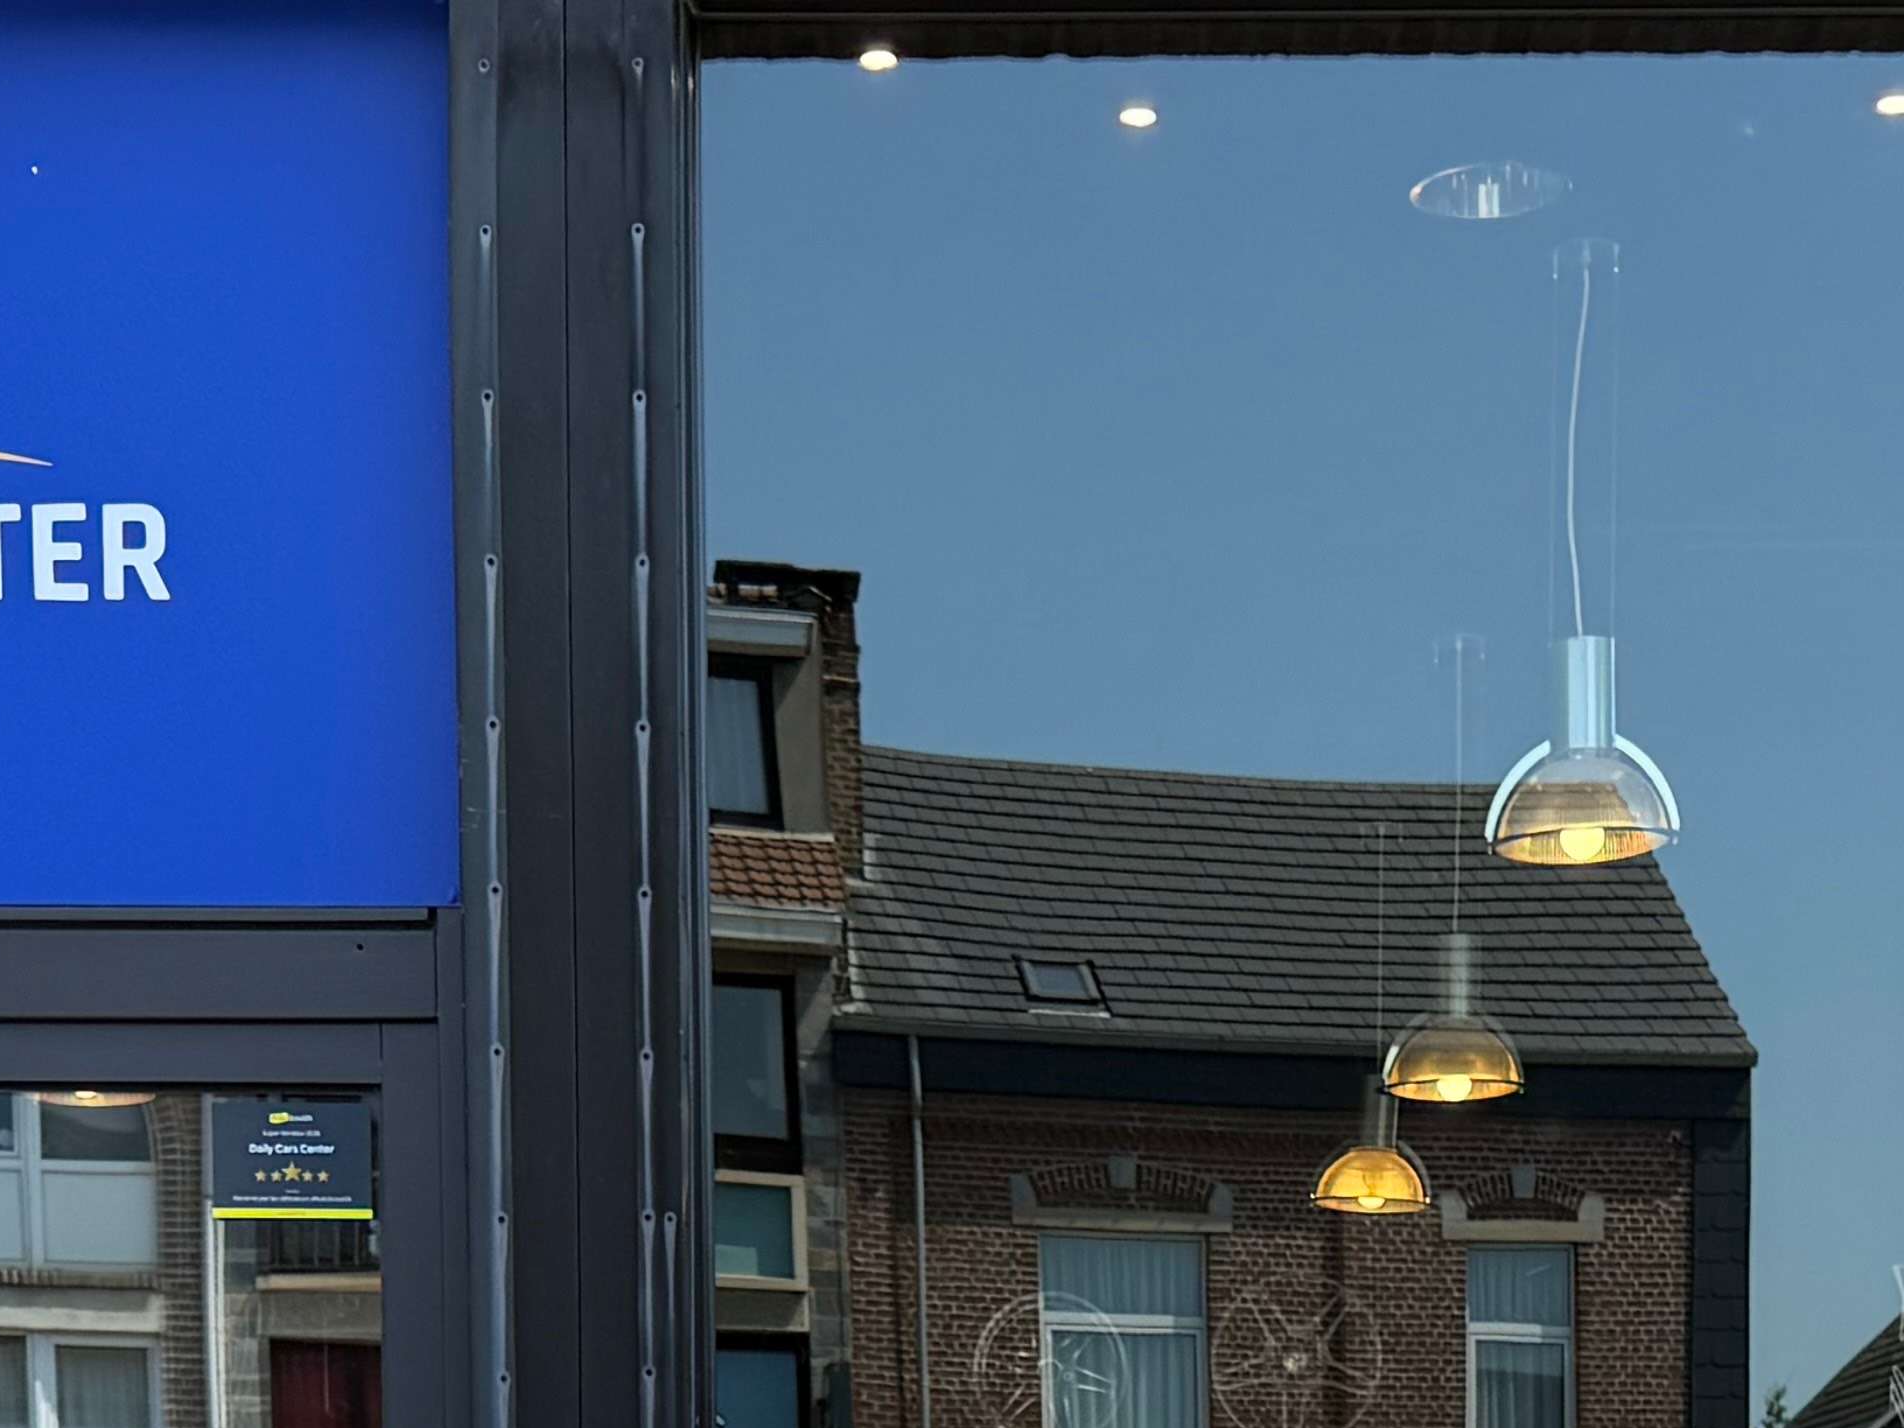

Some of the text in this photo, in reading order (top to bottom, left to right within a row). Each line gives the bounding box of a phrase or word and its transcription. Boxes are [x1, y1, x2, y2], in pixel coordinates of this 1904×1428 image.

[248, 1143, 335, 1155] Daily Cars Center
